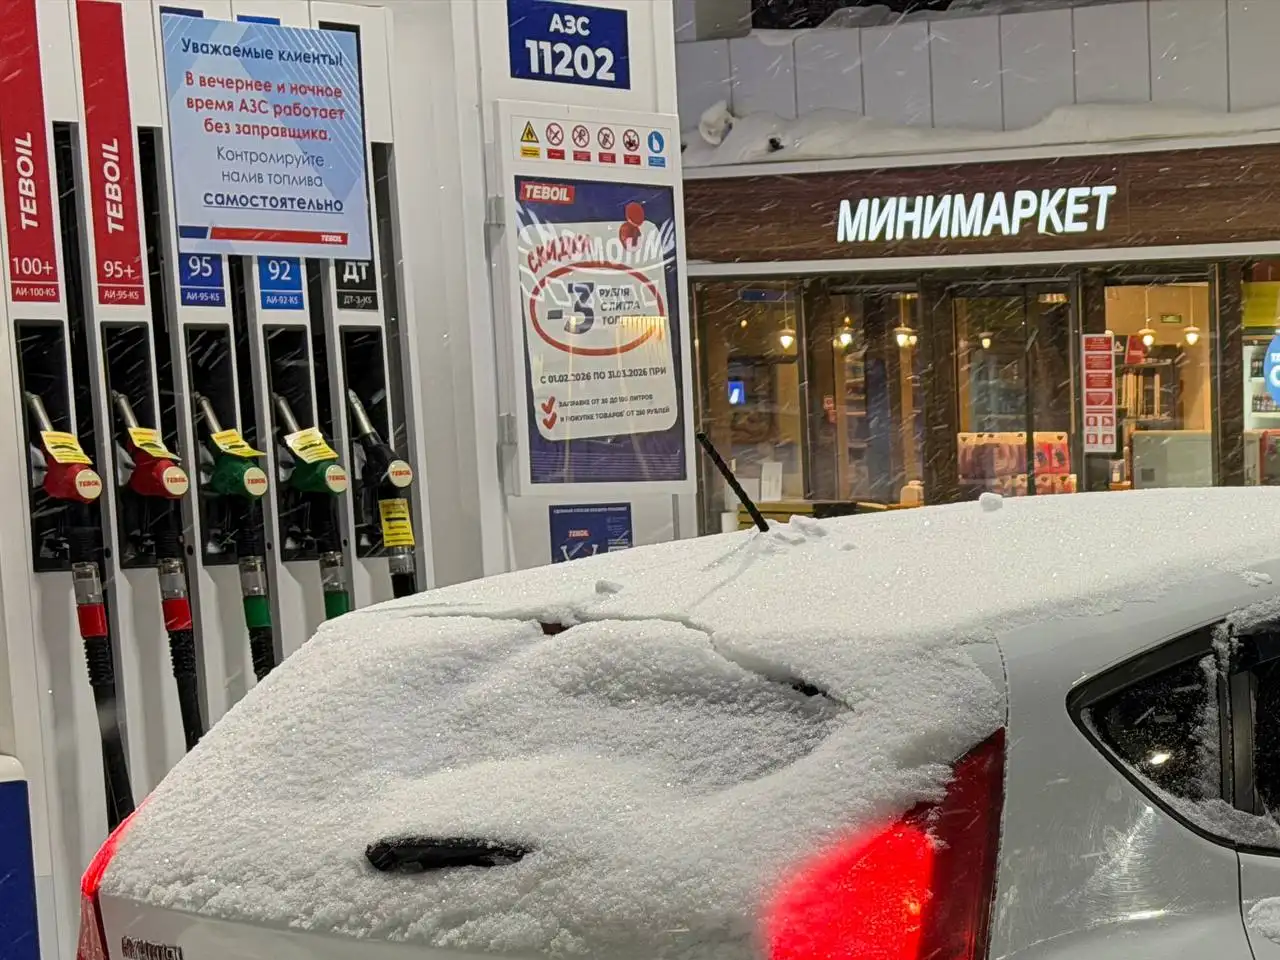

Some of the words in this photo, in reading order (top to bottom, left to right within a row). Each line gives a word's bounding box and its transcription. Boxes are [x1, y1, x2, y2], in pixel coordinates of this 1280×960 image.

[549, 13, 591, 36] АЗС
[181, 37, 274, 60] Уважаемые
[279, 49, 343, 66] клиенты!
[525, 39, 615, 81] 11202
[185, 71, 194, 86] В
[199, 75, 272, 93] вечернее
[277, 82, 286, 92] и
[290, 83, 342, 98] ночное
[187, 98, 234, 112] время
[239, 98, 269, 114] АЗС
[273, 103, 345, 120] работает
[204, 117, 230, 134] без
[235, 123, 332, 141] заправщика.
[216, 146, 324, 168] Контролируйте
[14, 132, 39, 230] TEBOIL
[102, 138, 125, 234] TEBOIL
[222, 171, 264, 183] налив
[267, 174, 323, 187] топлива
[203, 192, 344, 212] самостоятельно
[524, 185, 569, 201] TEBOIL
[836, 185, 1117, 243] МИНИМАРКЕТ
[12, 257, 54, 275] 100+
[103, 260, 135, 278] 95+
[188, 255, 213, 277] 95
[268, 260, 292, 281] 92
[343, 261, 370, 283] ДТ
